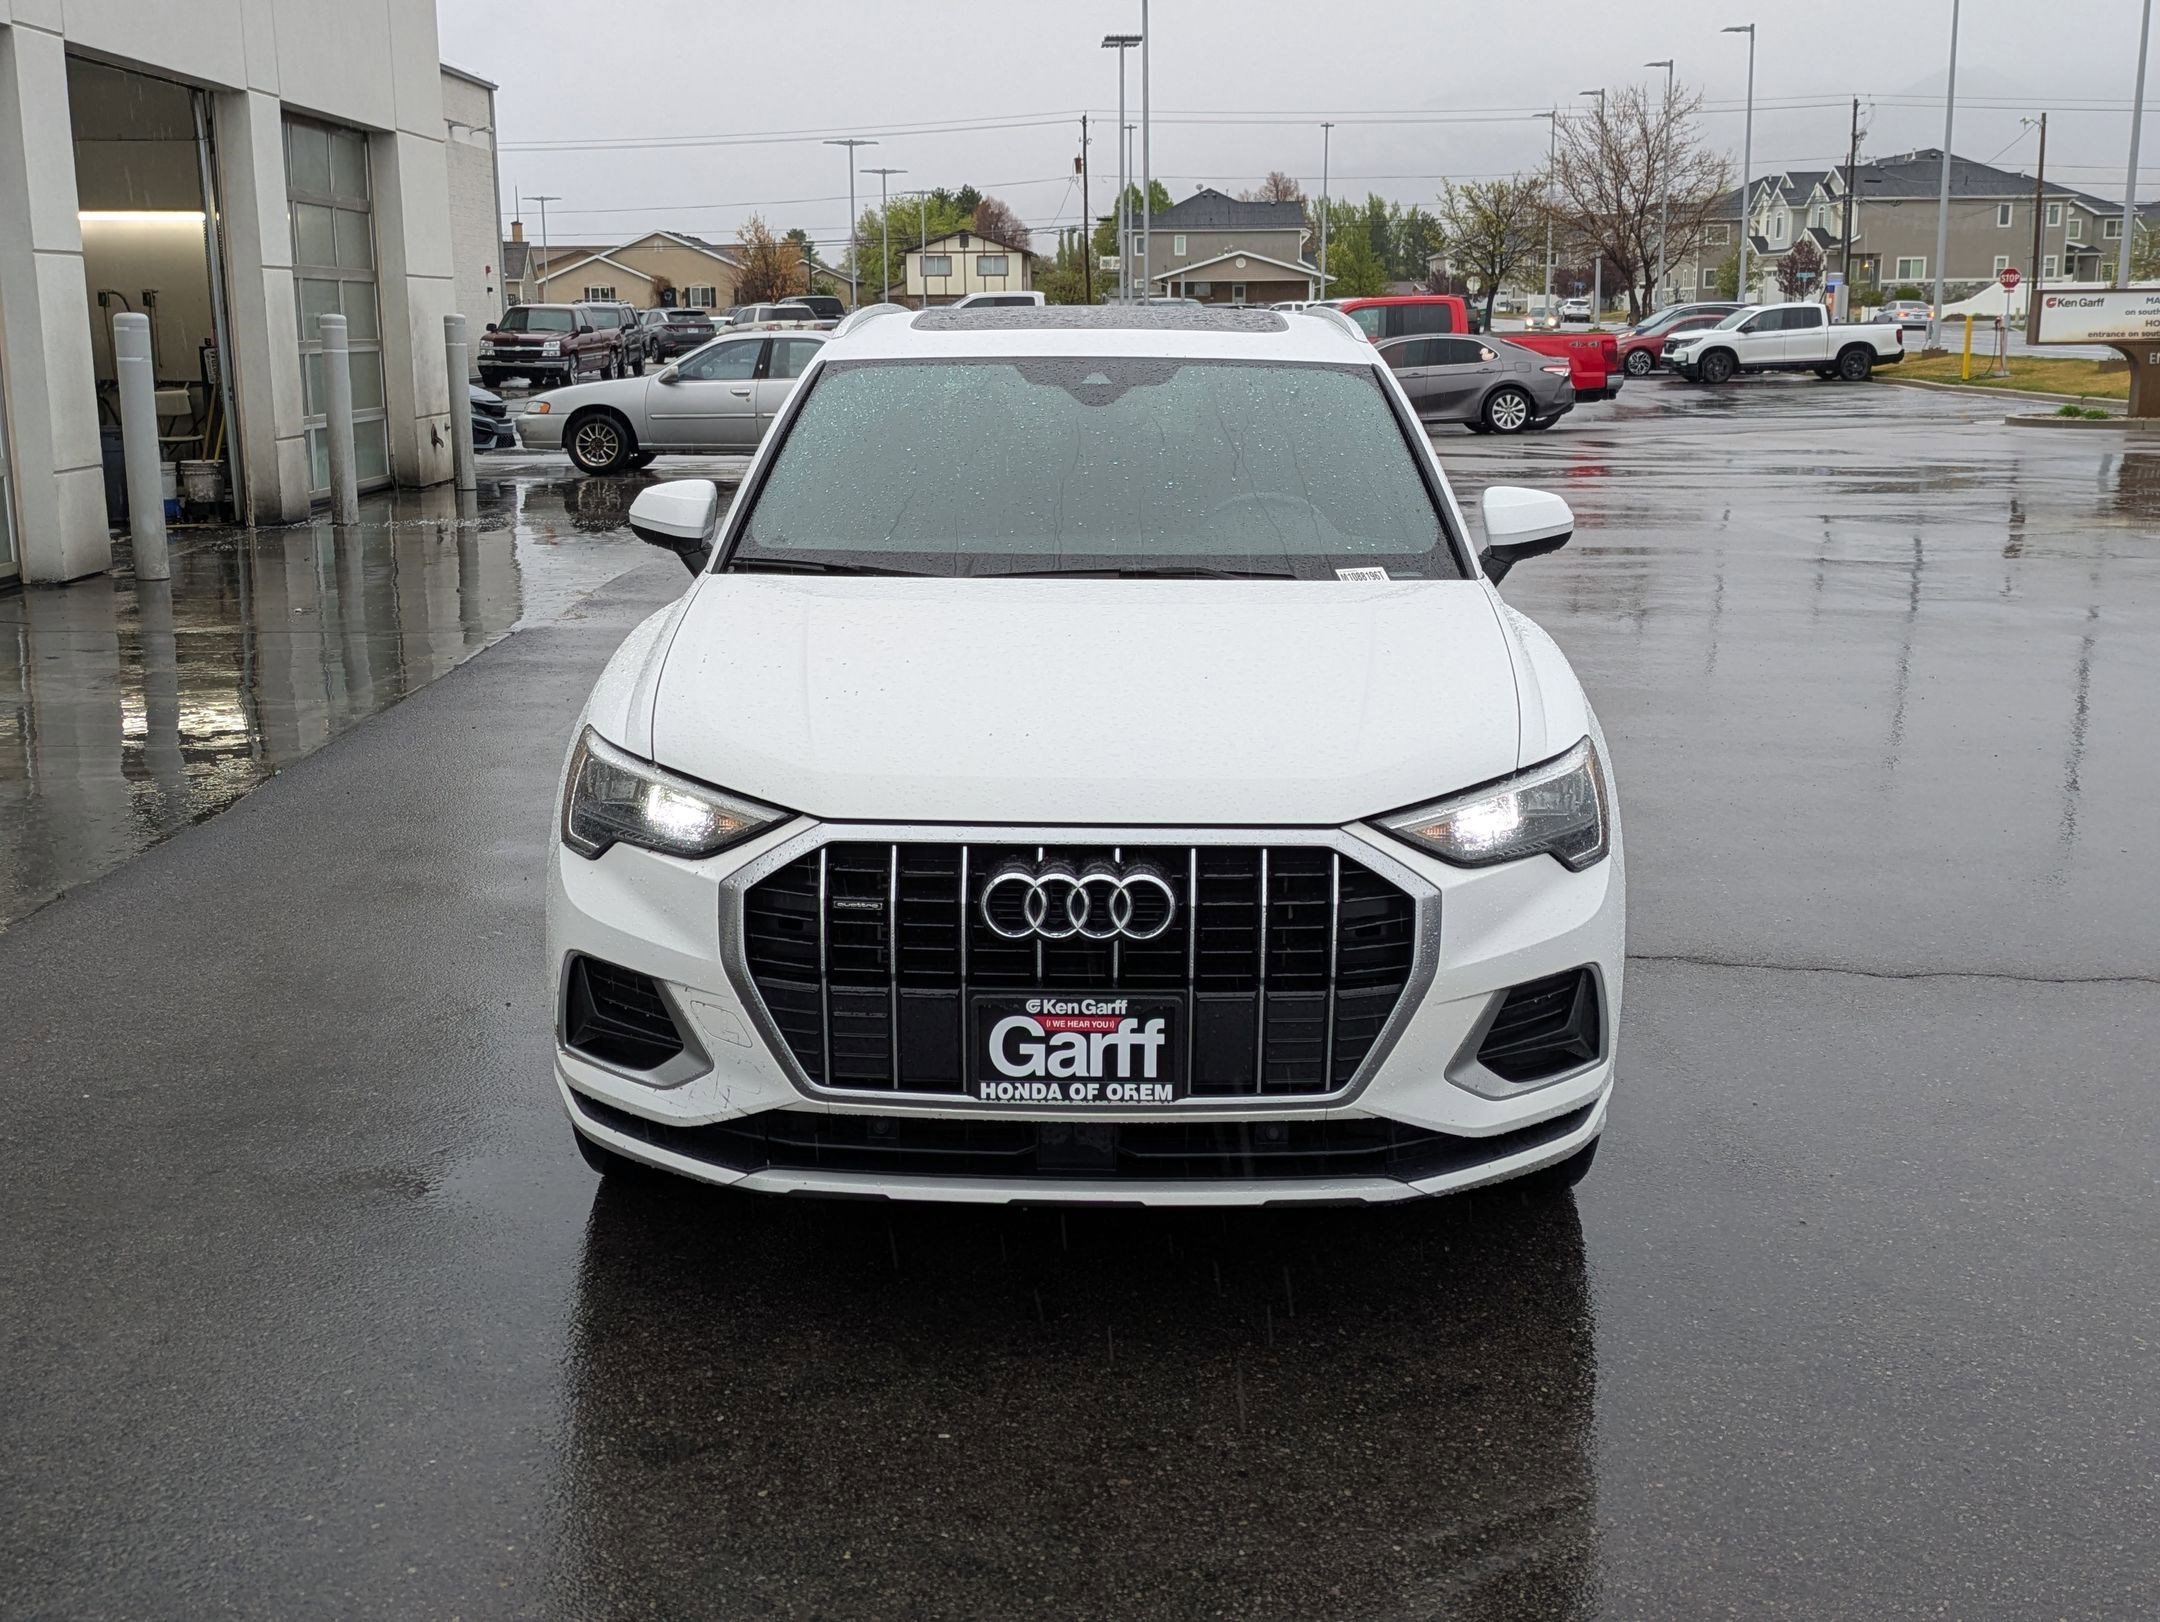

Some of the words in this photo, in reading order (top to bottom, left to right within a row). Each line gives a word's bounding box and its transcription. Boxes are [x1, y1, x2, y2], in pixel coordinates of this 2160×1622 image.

[2001, 274, 2020, 282] STOP
[2058, 298, 2078, 307] Ken
[2079, 298, 2104, 307] Garff
[1043, 999, 1080, 1014] Ken
[1081, 999, 1128, 1014] Garff
[1052, 1020, 1066, 1028] WE
[1067, 1020, 1090, 1028] HEAR
[1091, 1020, 1109, 1028] YOU
[988, 1016, 1165, 1078] Garff
[980, 1082, 1062, 1100] HONDA
[1069, 1083, 1100, 1100] OF
[1106, 1084, 1173, 1101] OREM
